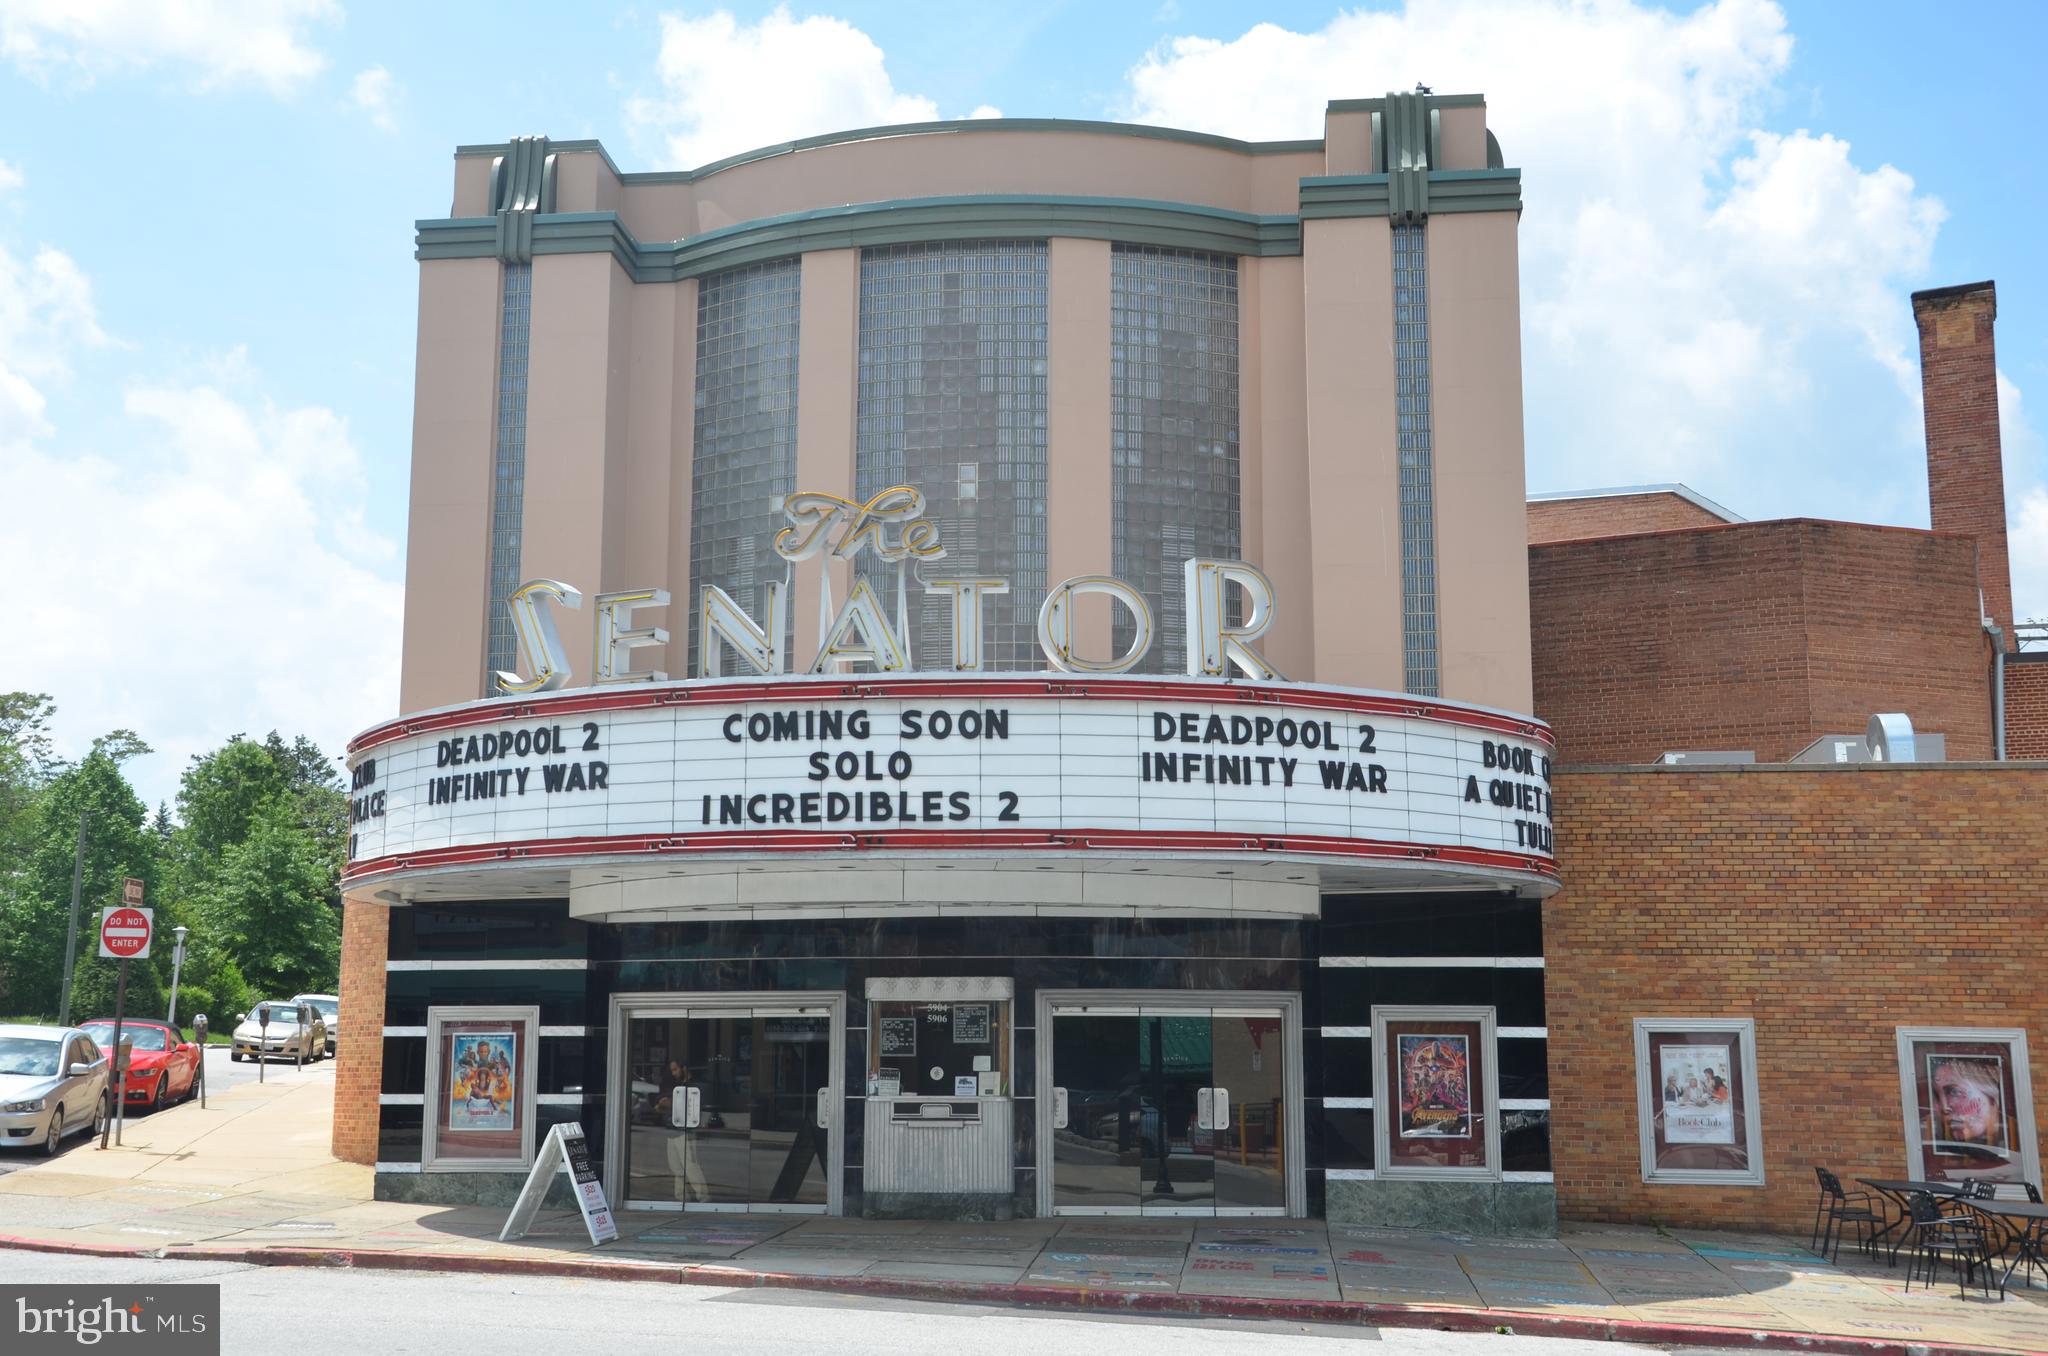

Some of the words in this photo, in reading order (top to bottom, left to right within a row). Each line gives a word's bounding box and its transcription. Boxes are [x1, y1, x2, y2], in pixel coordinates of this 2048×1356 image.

[775, 484, 948, 562] The
[496, 557, 1288, 693] SENATOR
[722, 709, 871, 743] COMING
[900, 708, 1009, 740] SOON
[1152, 711, 1340, 752] DEADPOOL
[1359, 724, 1377, 754] 2
[436, 724, 567, 768] DEADPOOL
[582, 722, 600, 751] 2
[1482, 740, 1535, 777] BOOK
[428, 766, 531, 807] INFINITY
[543, 761, 609, 793] WAR
[807, 750, 913, 782] SOLO
[1142, 751, 1298, 788] INFINITY
[1318, 760, 1388, 794] WAR
[702, 791, 971, 825] INCREDIBLES
[998, 790, 1020, 822] 2
[1464, 774, 1482, 803] A
[1489, 779, 1542, 814] QUIET
[110, 917, 122, 926] DO
[127, 917, 144, 926] NOT
[112, 939, 138, 947] ENTER
[928, 1014, 948, 1023] 5906
